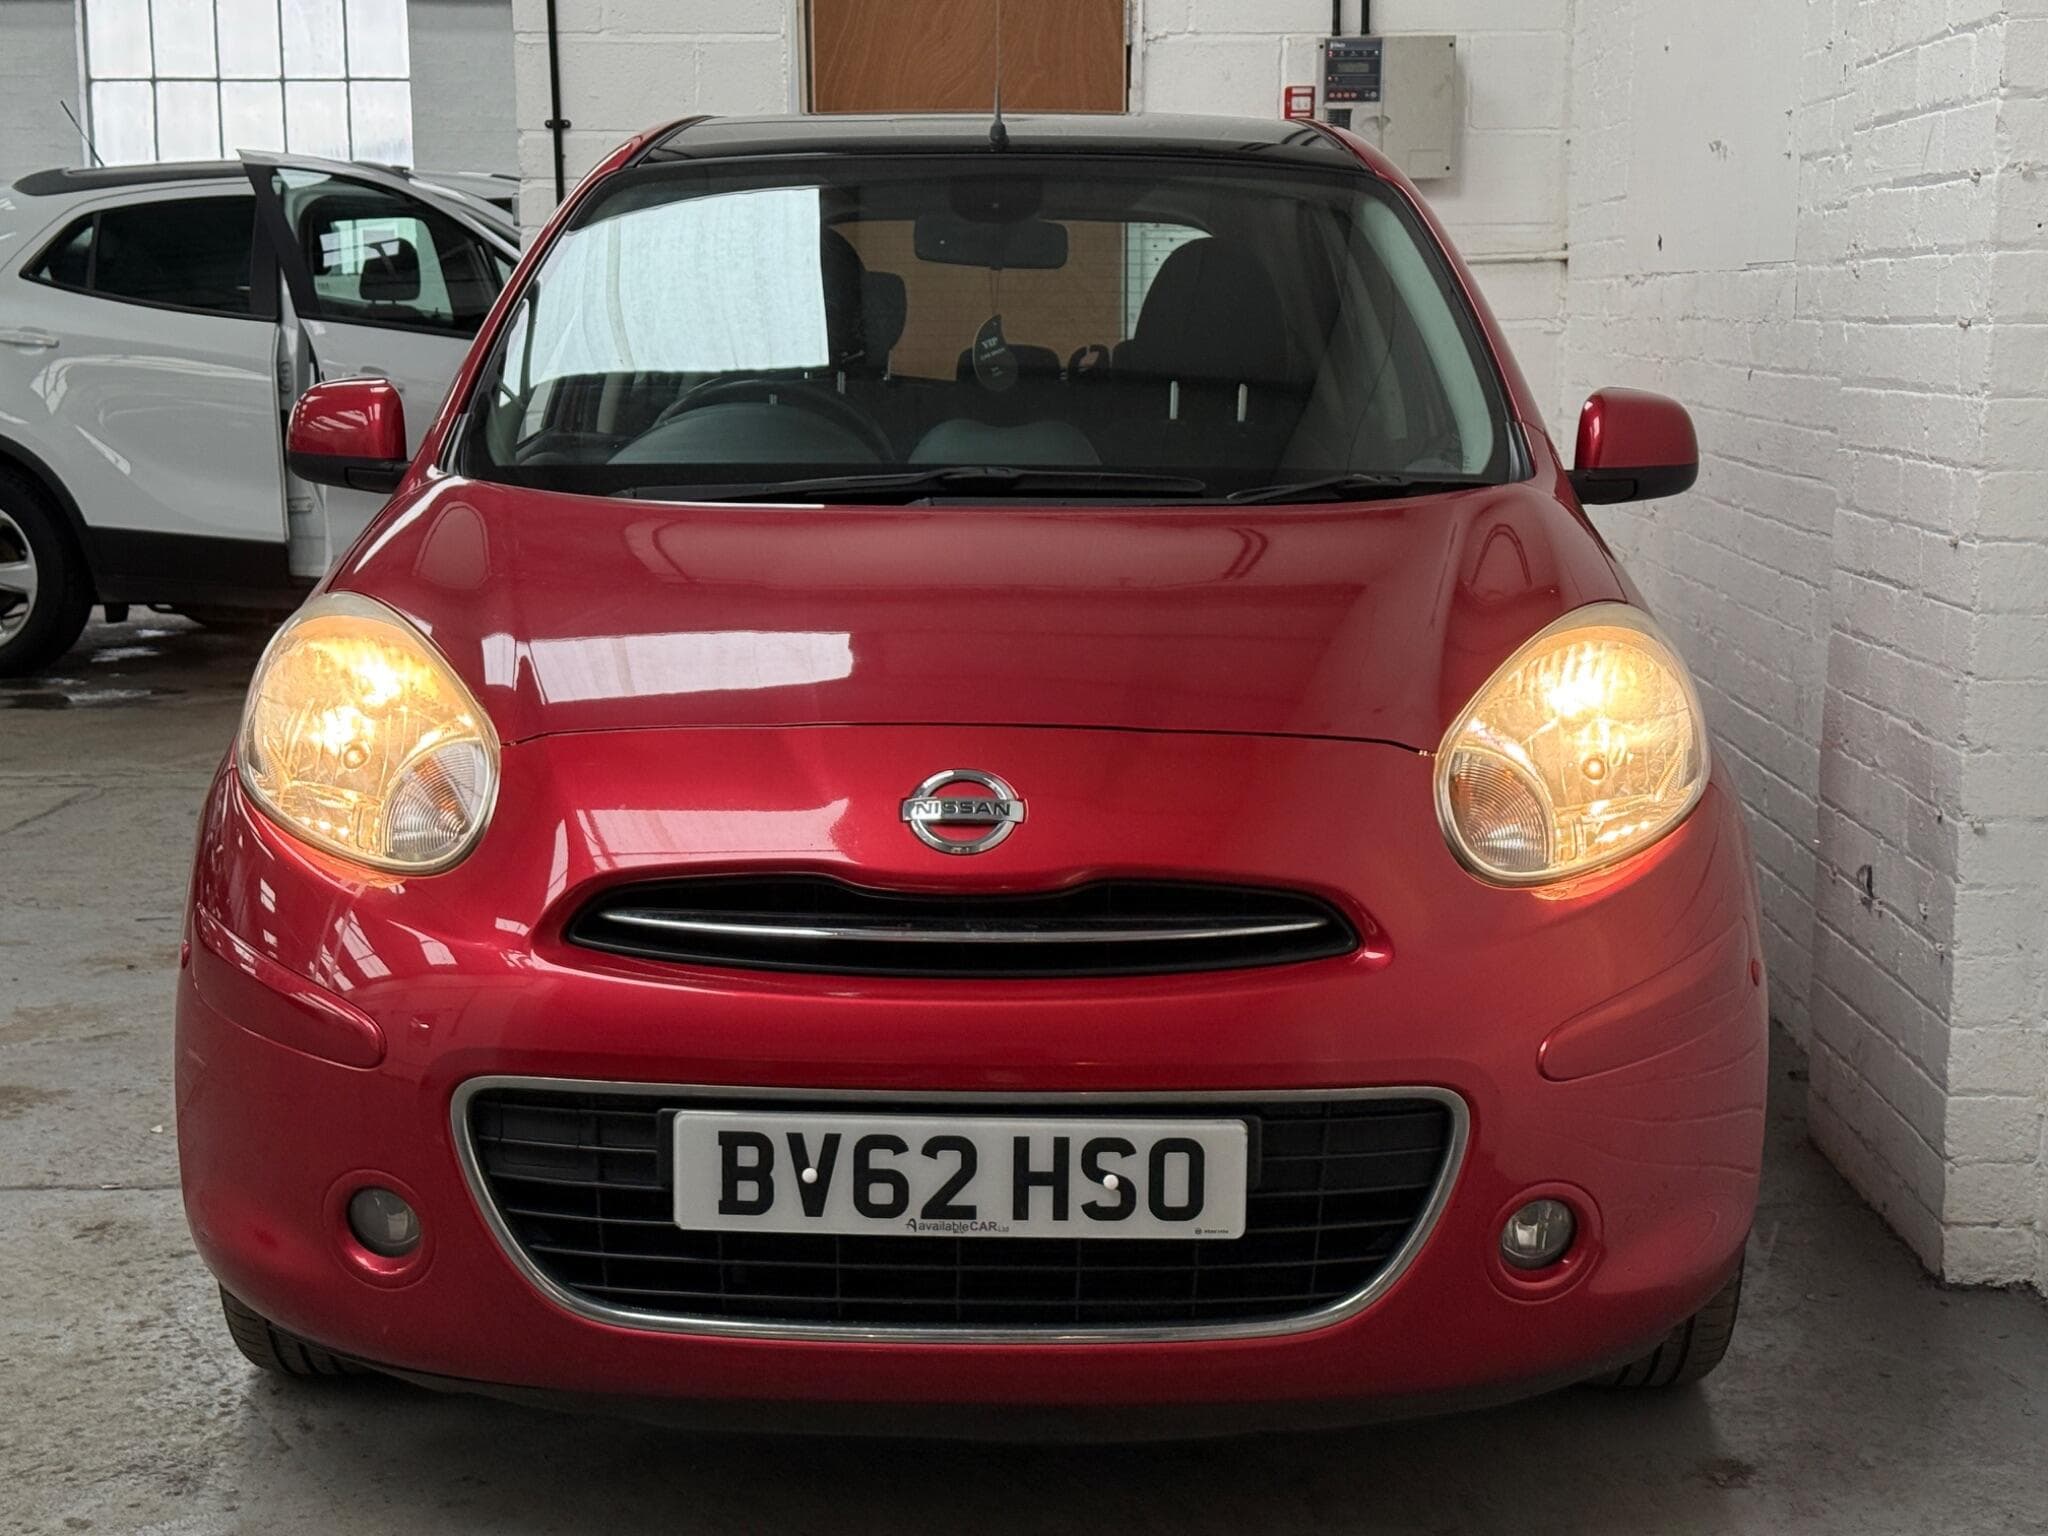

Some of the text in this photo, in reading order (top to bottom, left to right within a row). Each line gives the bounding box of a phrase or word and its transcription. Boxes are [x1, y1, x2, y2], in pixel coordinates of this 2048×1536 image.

[913, 800, 1011, 817] NISSAN
[718, 1131, 1205, 1221] BV62 HSO
